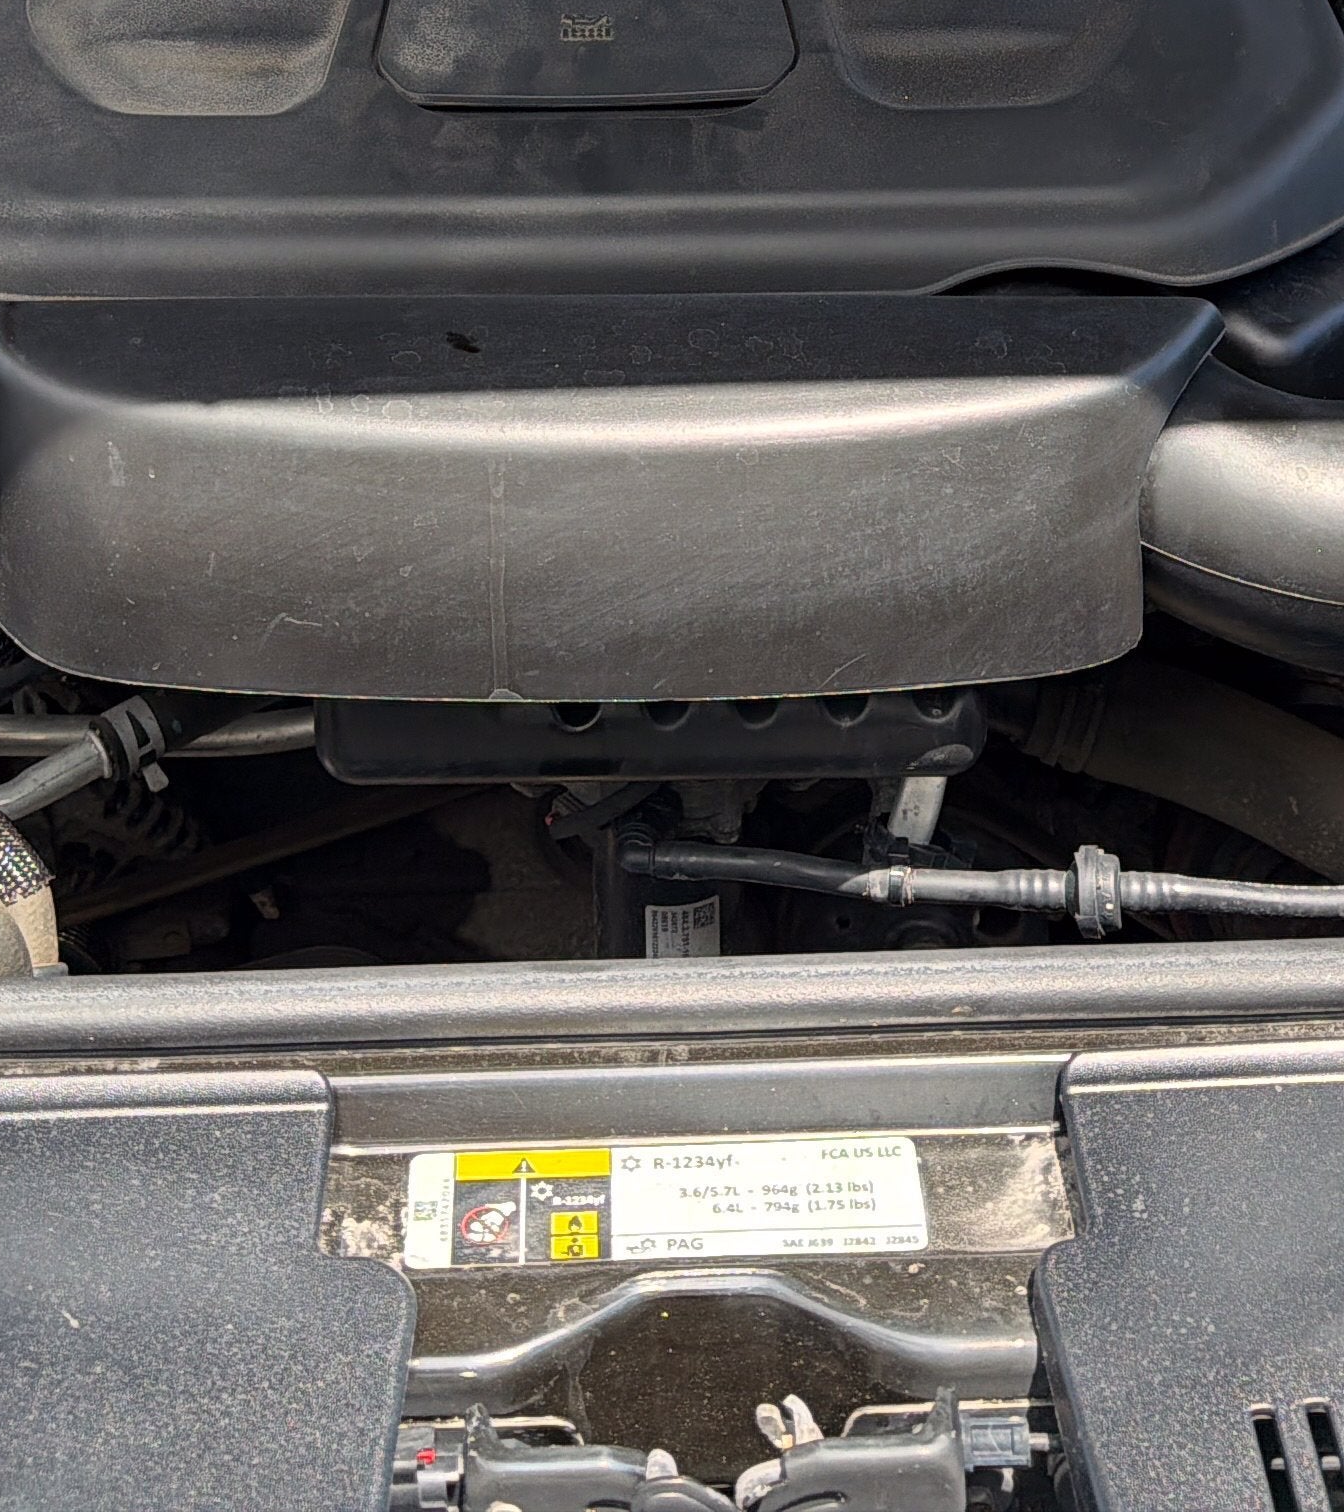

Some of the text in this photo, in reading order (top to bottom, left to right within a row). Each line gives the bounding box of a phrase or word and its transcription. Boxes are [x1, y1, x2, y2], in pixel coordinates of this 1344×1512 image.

[821, 1145, 902, 1160] FCA US LLC
[678, 1185, 740, 1200] 3.6/5.7L
[805, 1182, 843, 1196] (2.13
[847, 1180, 874, 1194] lbs)
[712, 1203, 743, 1215] 6.4L
[807, 1199, 846, 1213] (1.75
[849, 1197, 876, 1211] lbs)
[666, 1238, 704, 1251] PAG
